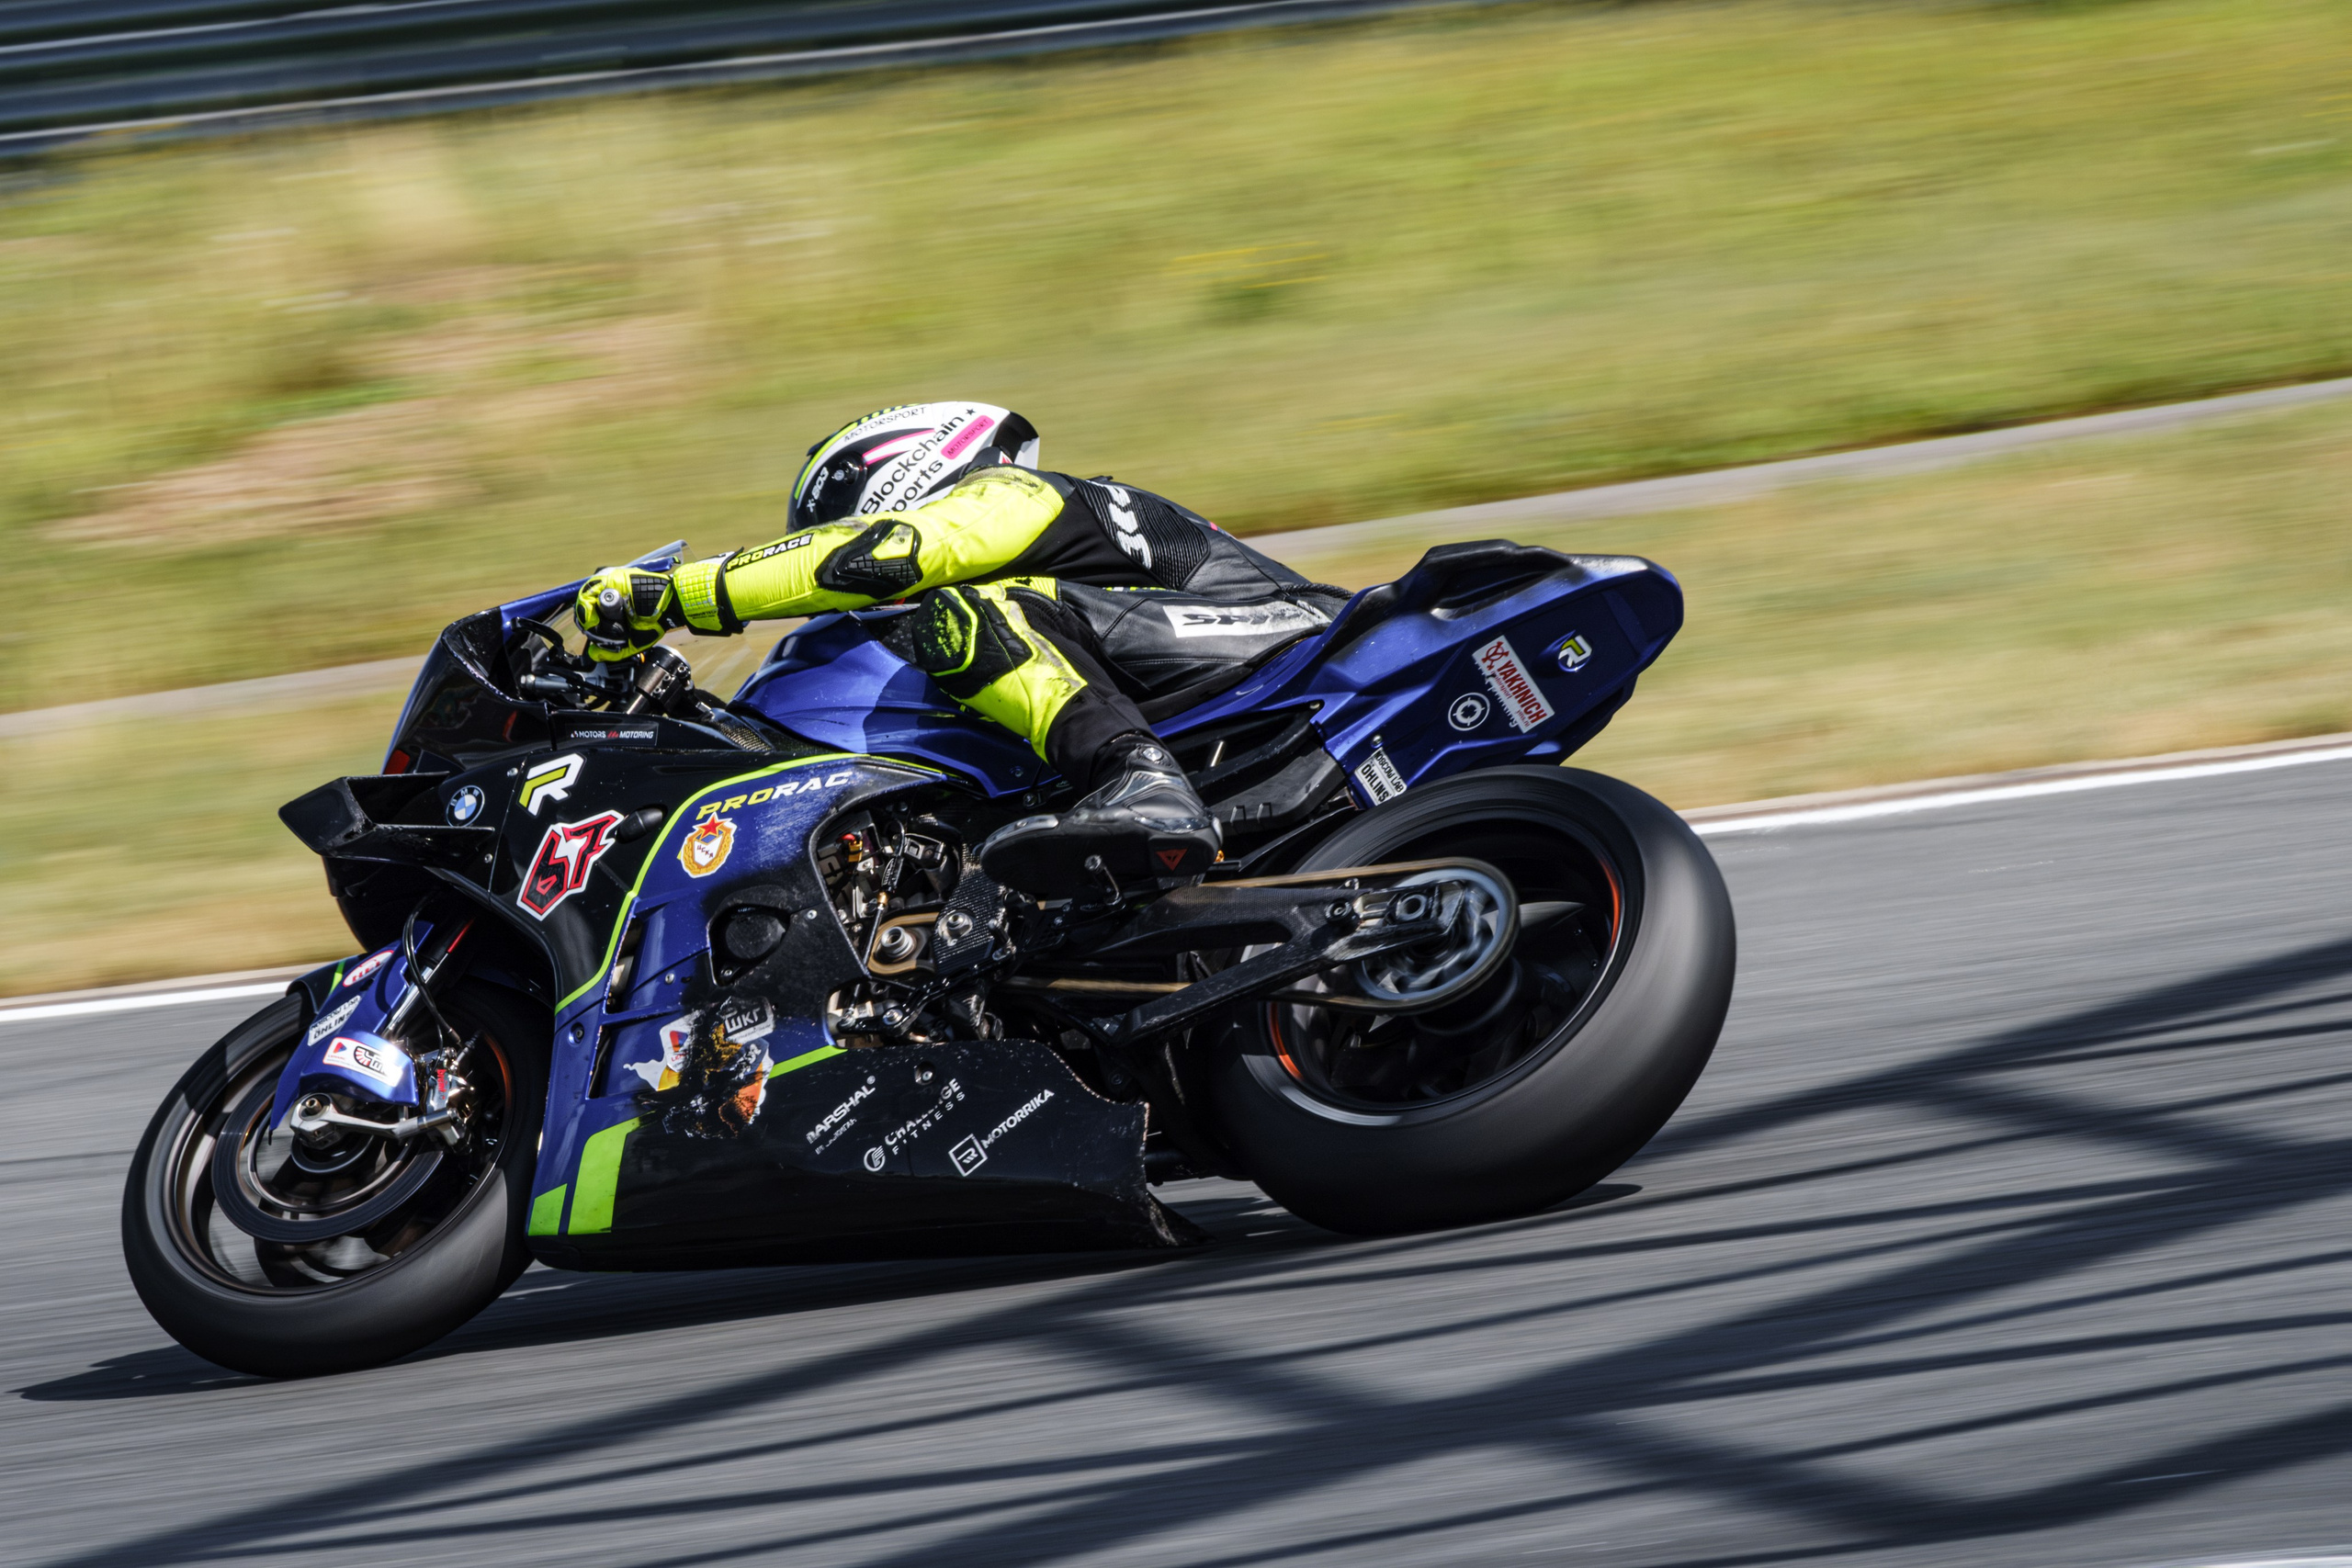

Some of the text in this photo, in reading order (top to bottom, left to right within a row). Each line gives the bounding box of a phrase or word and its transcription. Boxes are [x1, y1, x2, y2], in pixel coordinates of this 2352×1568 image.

[860, 413, 965, 516] Blockchain
[885, 459, 944, 513] ports
[727, 535, 812, 570] PRORACE
[1497, 660, 1547, 726] YAKHNICH
[618, 729, 654, 740] MOTORING
[1361, 761, 1389, 803] ÖHLINS
[980, 1089, 1055, 1149] MOTORRIKA
